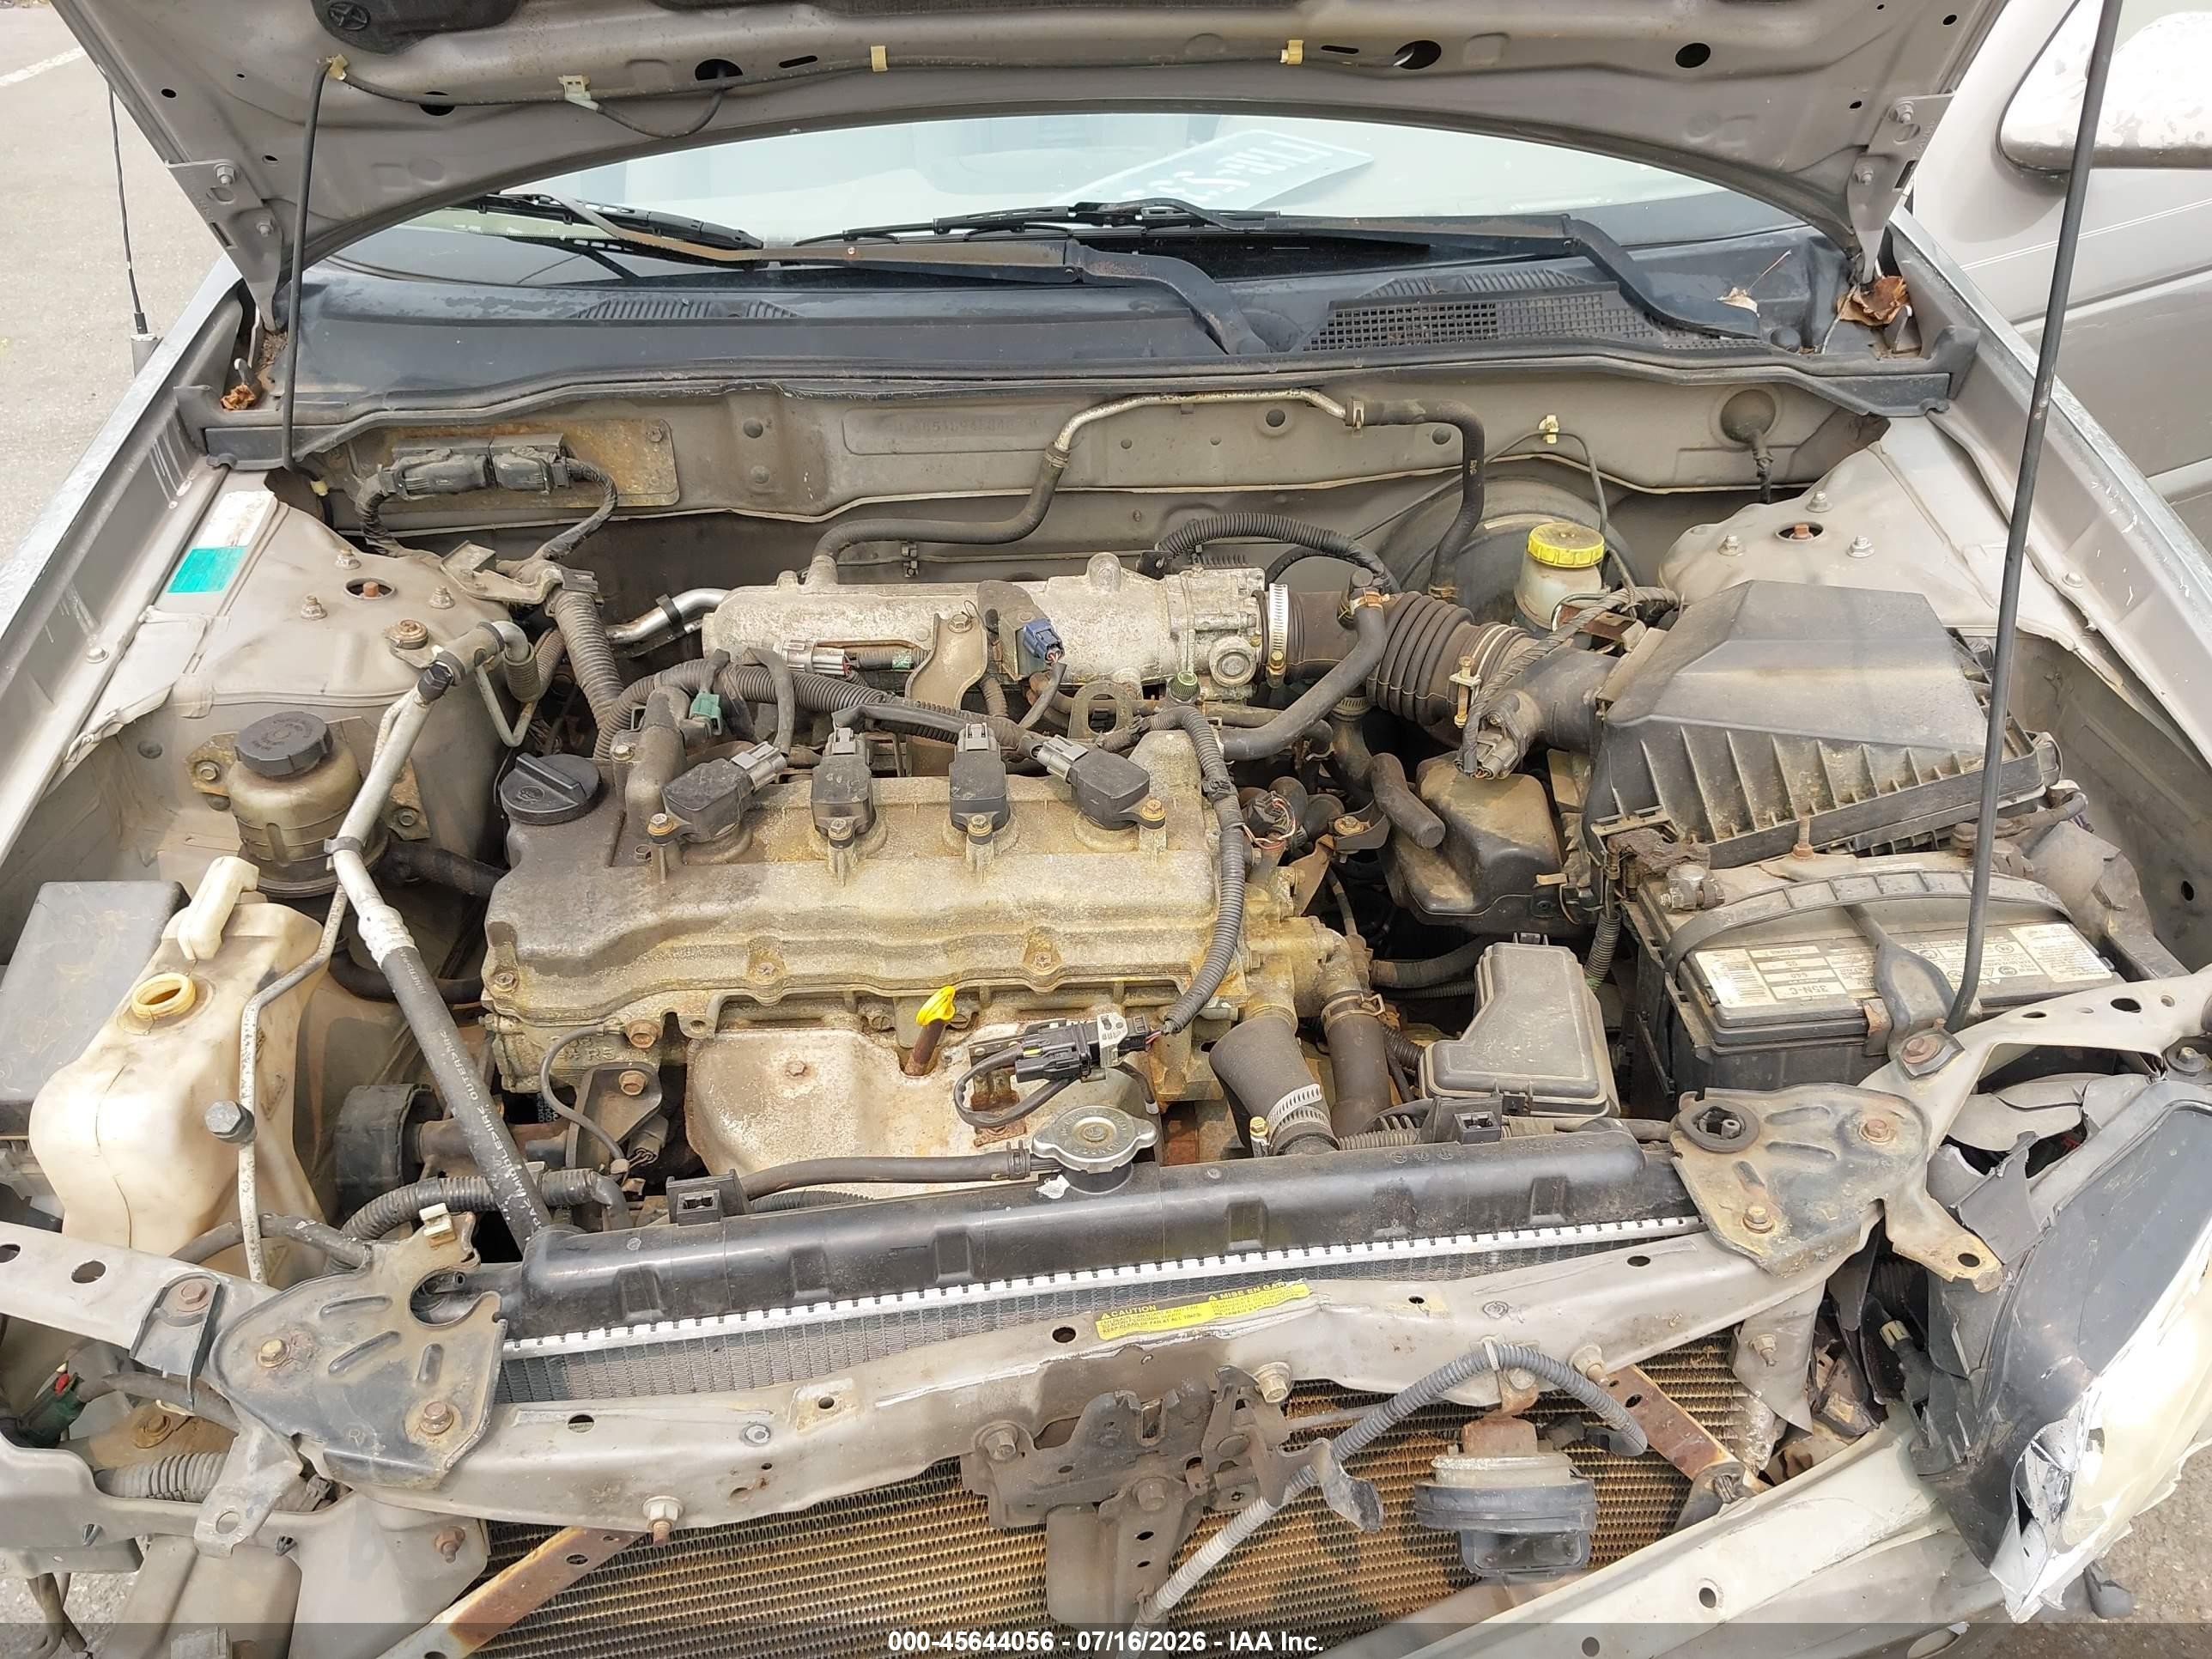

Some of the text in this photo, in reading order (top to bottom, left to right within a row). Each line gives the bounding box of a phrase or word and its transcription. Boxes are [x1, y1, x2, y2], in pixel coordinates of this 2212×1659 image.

[1789, 985, 1828, 995] 35N-C
[1220, 1290, 1244, 1299] MISE
[1247, 1287, 1261, 1296] EN
[1111, 1304, 1157, 1317] CAUTION
